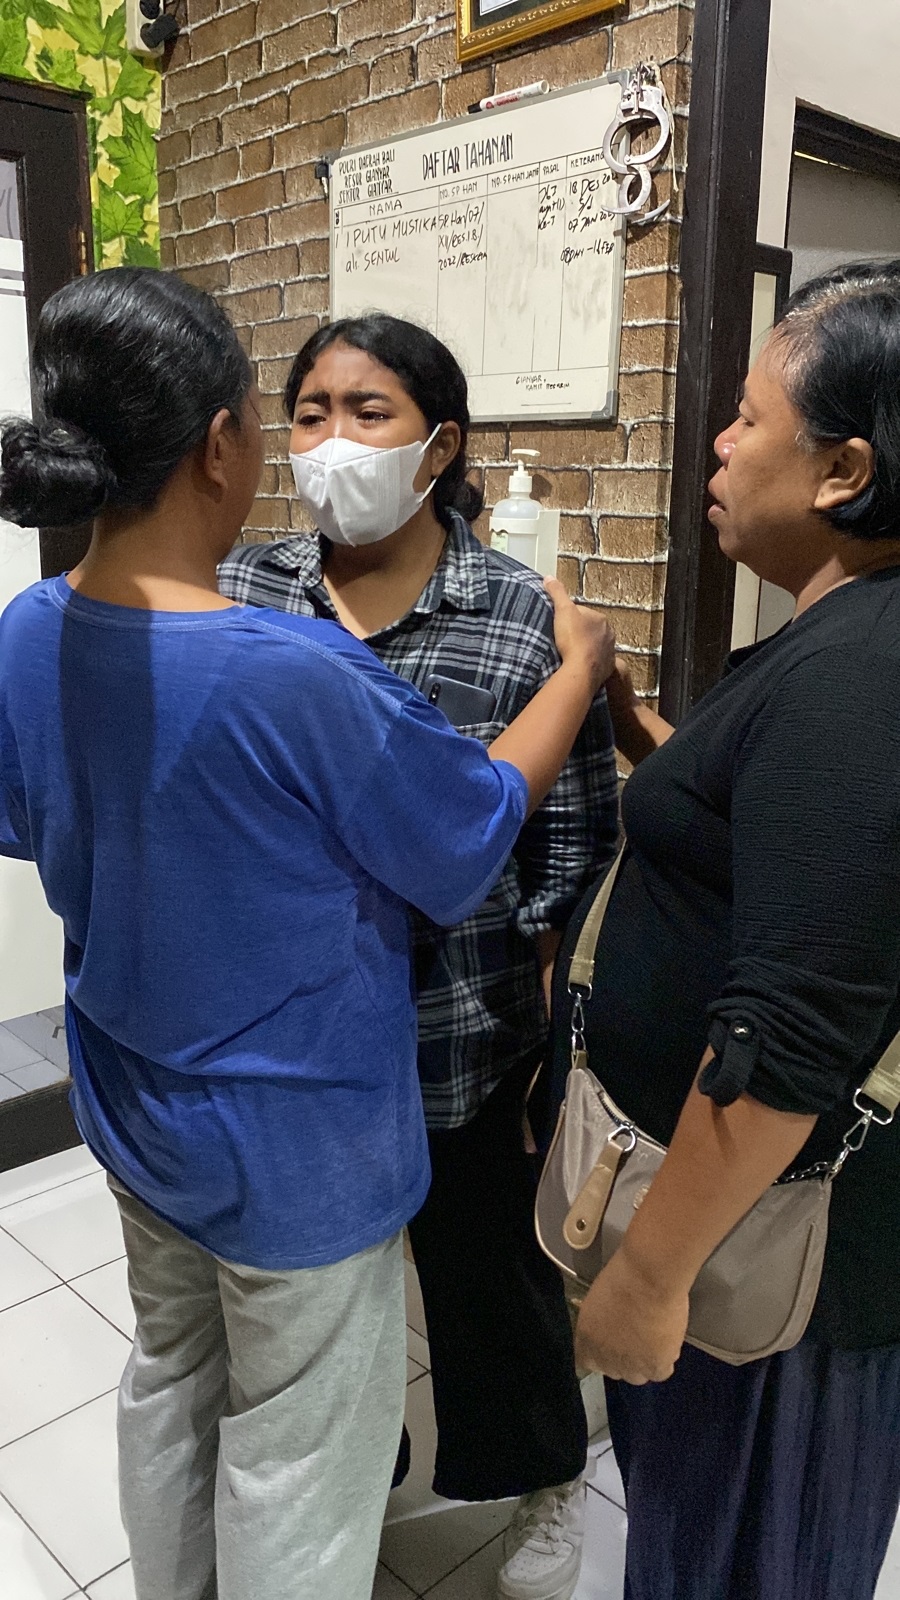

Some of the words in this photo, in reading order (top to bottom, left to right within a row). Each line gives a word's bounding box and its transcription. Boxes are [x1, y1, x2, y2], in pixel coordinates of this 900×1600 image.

[382, 149, 395, 164] BALI
[422, 146, 460, 181] DAFTAR
[464, 132, 513, 171] TAHANAN
[542, 163, 560, 176] PASAL
[462, 182, 478, 194] HAN
[568, 180, 578, 196] 18
[579, 178, 600, 201] DES
[369, 199, 403, 216] NAMA
[353, 225, 387, 248] PUTU
[393, 217, 437, 239] MUSTIKA
[568, 218, 578, 233] 07
[364, 247, 401, 272] SENTUL
